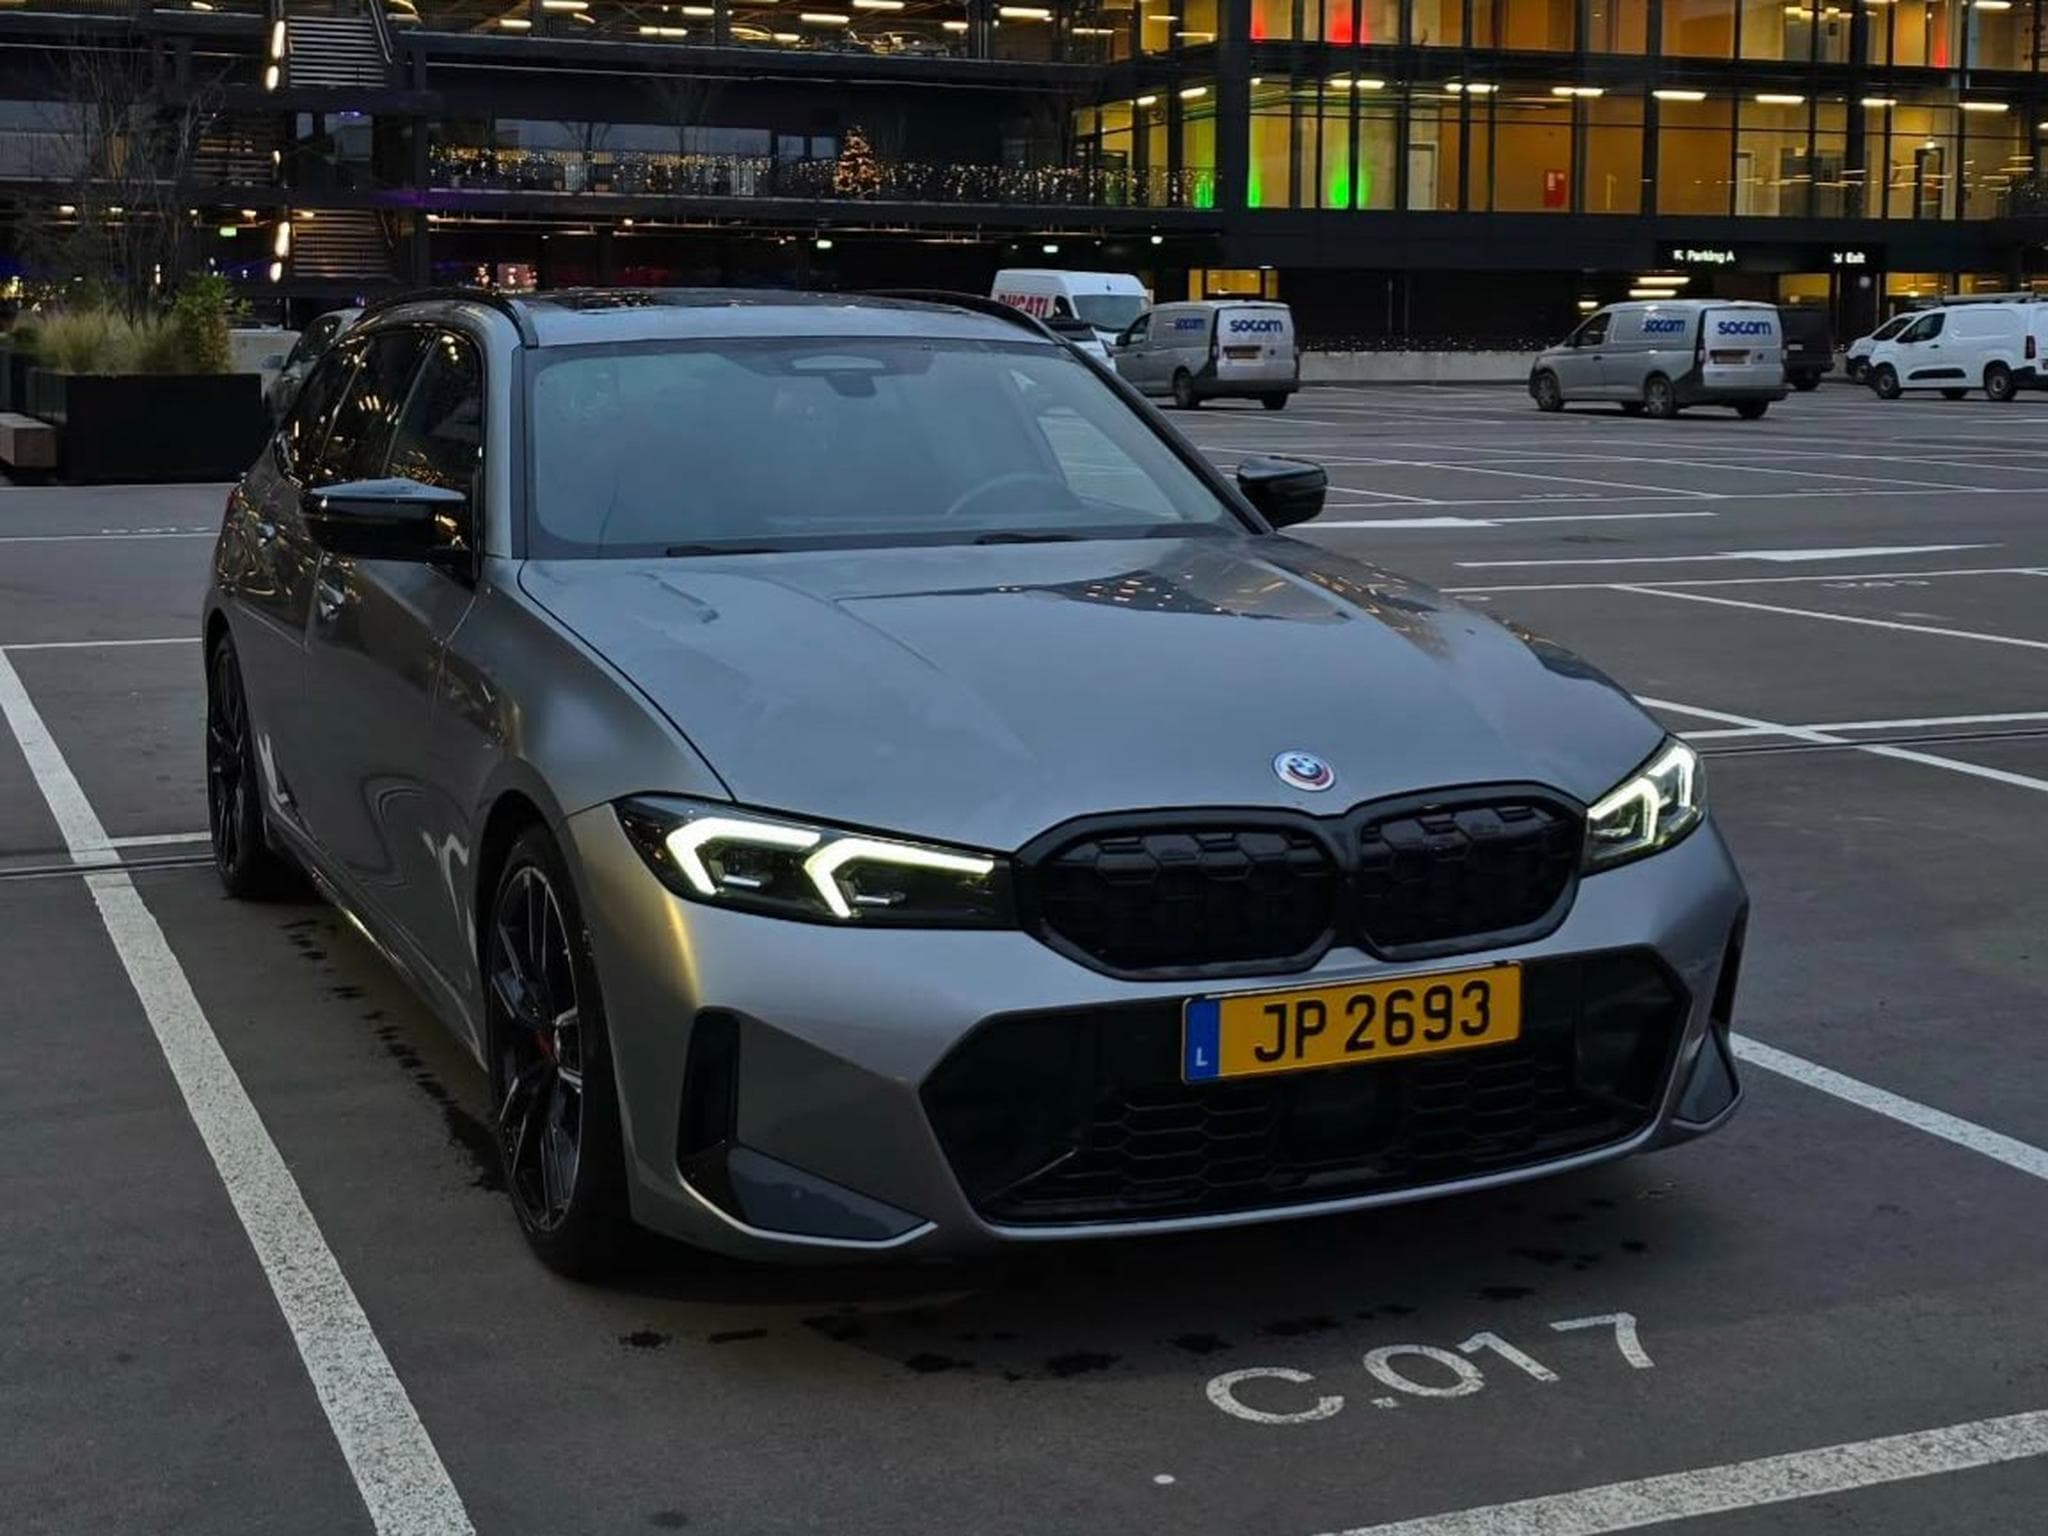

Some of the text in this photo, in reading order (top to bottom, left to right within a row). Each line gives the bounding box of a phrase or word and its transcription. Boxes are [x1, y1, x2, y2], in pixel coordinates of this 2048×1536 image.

[1686, 250, 1735, 264] Parking A
[1230, 319, 1283, 333] socom
[1717, 321, 1772, 335] socom
[1254, 980, 1491, 1063] JP 2693
[1195, 1047, 1208, 1067] L
[1205, 1311, 1655, 1424] C.017
